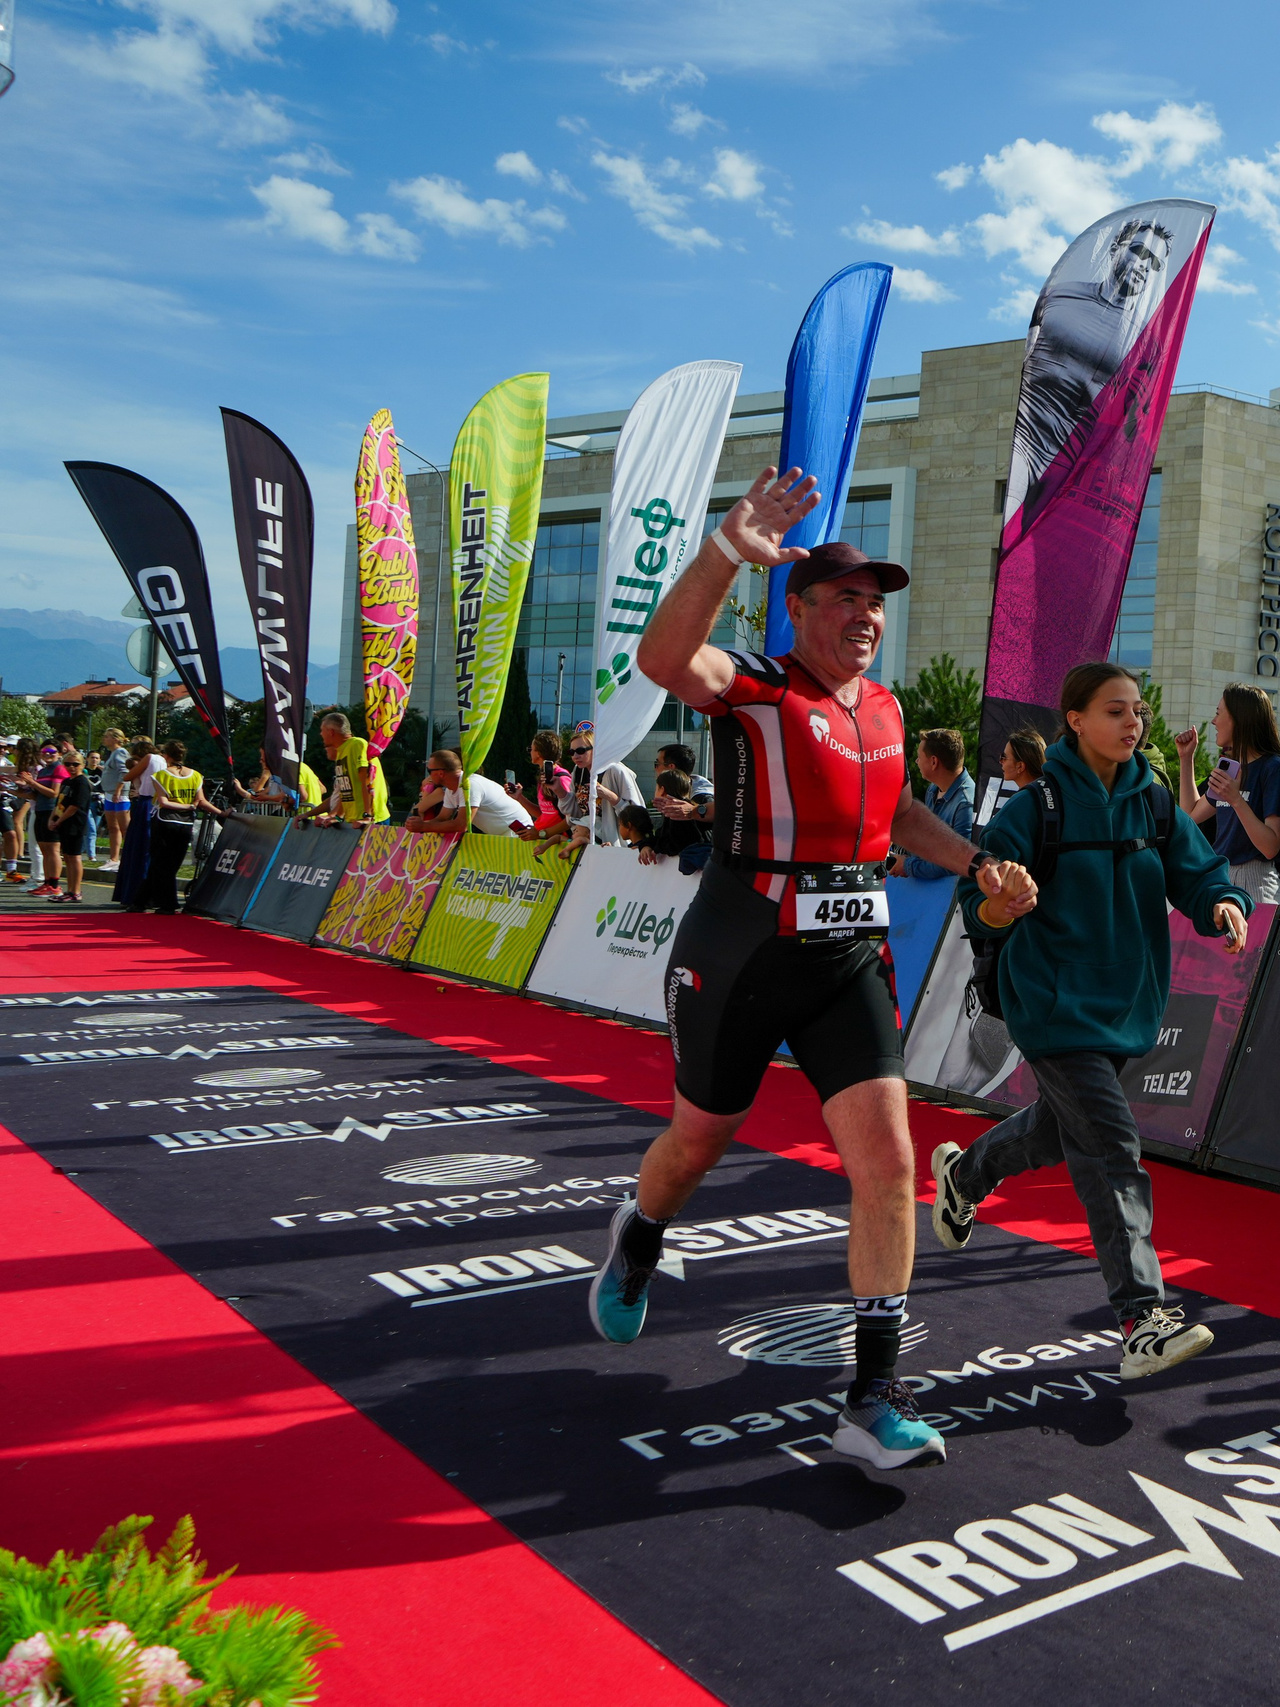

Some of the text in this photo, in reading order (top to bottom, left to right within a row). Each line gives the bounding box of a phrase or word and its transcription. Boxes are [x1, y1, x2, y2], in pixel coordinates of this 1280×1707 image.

[360, 551, 412, 582] Dubl
[606, 497, 686, 635] Шеф
[361, 575, 419, 618] Bubl
[457, 482, 487, 733] FAHRENHEIT
[731, 735, 747, 856] TRIATHLON SCHOOL
[1043, 787, 1055, 810] arena
[452, 867, 555, 904] FAHRENHEIT
[445, 893, 490, 920] VITAMIN
[815, 898, 875, 923] 4502
[614, 901, 675, 955] Шеф
[828, 928, 855, 938] АНДРЕЙ
[607, 942, 649, 959] Перекрёсток
[20, 1036, 350, 1064] IRON STAR
[92, 1078, 457, 1111] Газпромбанк
[172, 1089, 423, 1114] Премиум
[1143, 1070, 1192, 1096] TELE2
[149, 1103, 543, 1149] IRON STAR
[270, 1173, 640, 1228] Газпромба
[377, 1191, 638, 1233] Премиу
[368, 1208, 851, 1298] IRON STAR
[620, 1328, 1122, 1461] Газпомбан
[835, 1493, 1156, 1625] IRON
